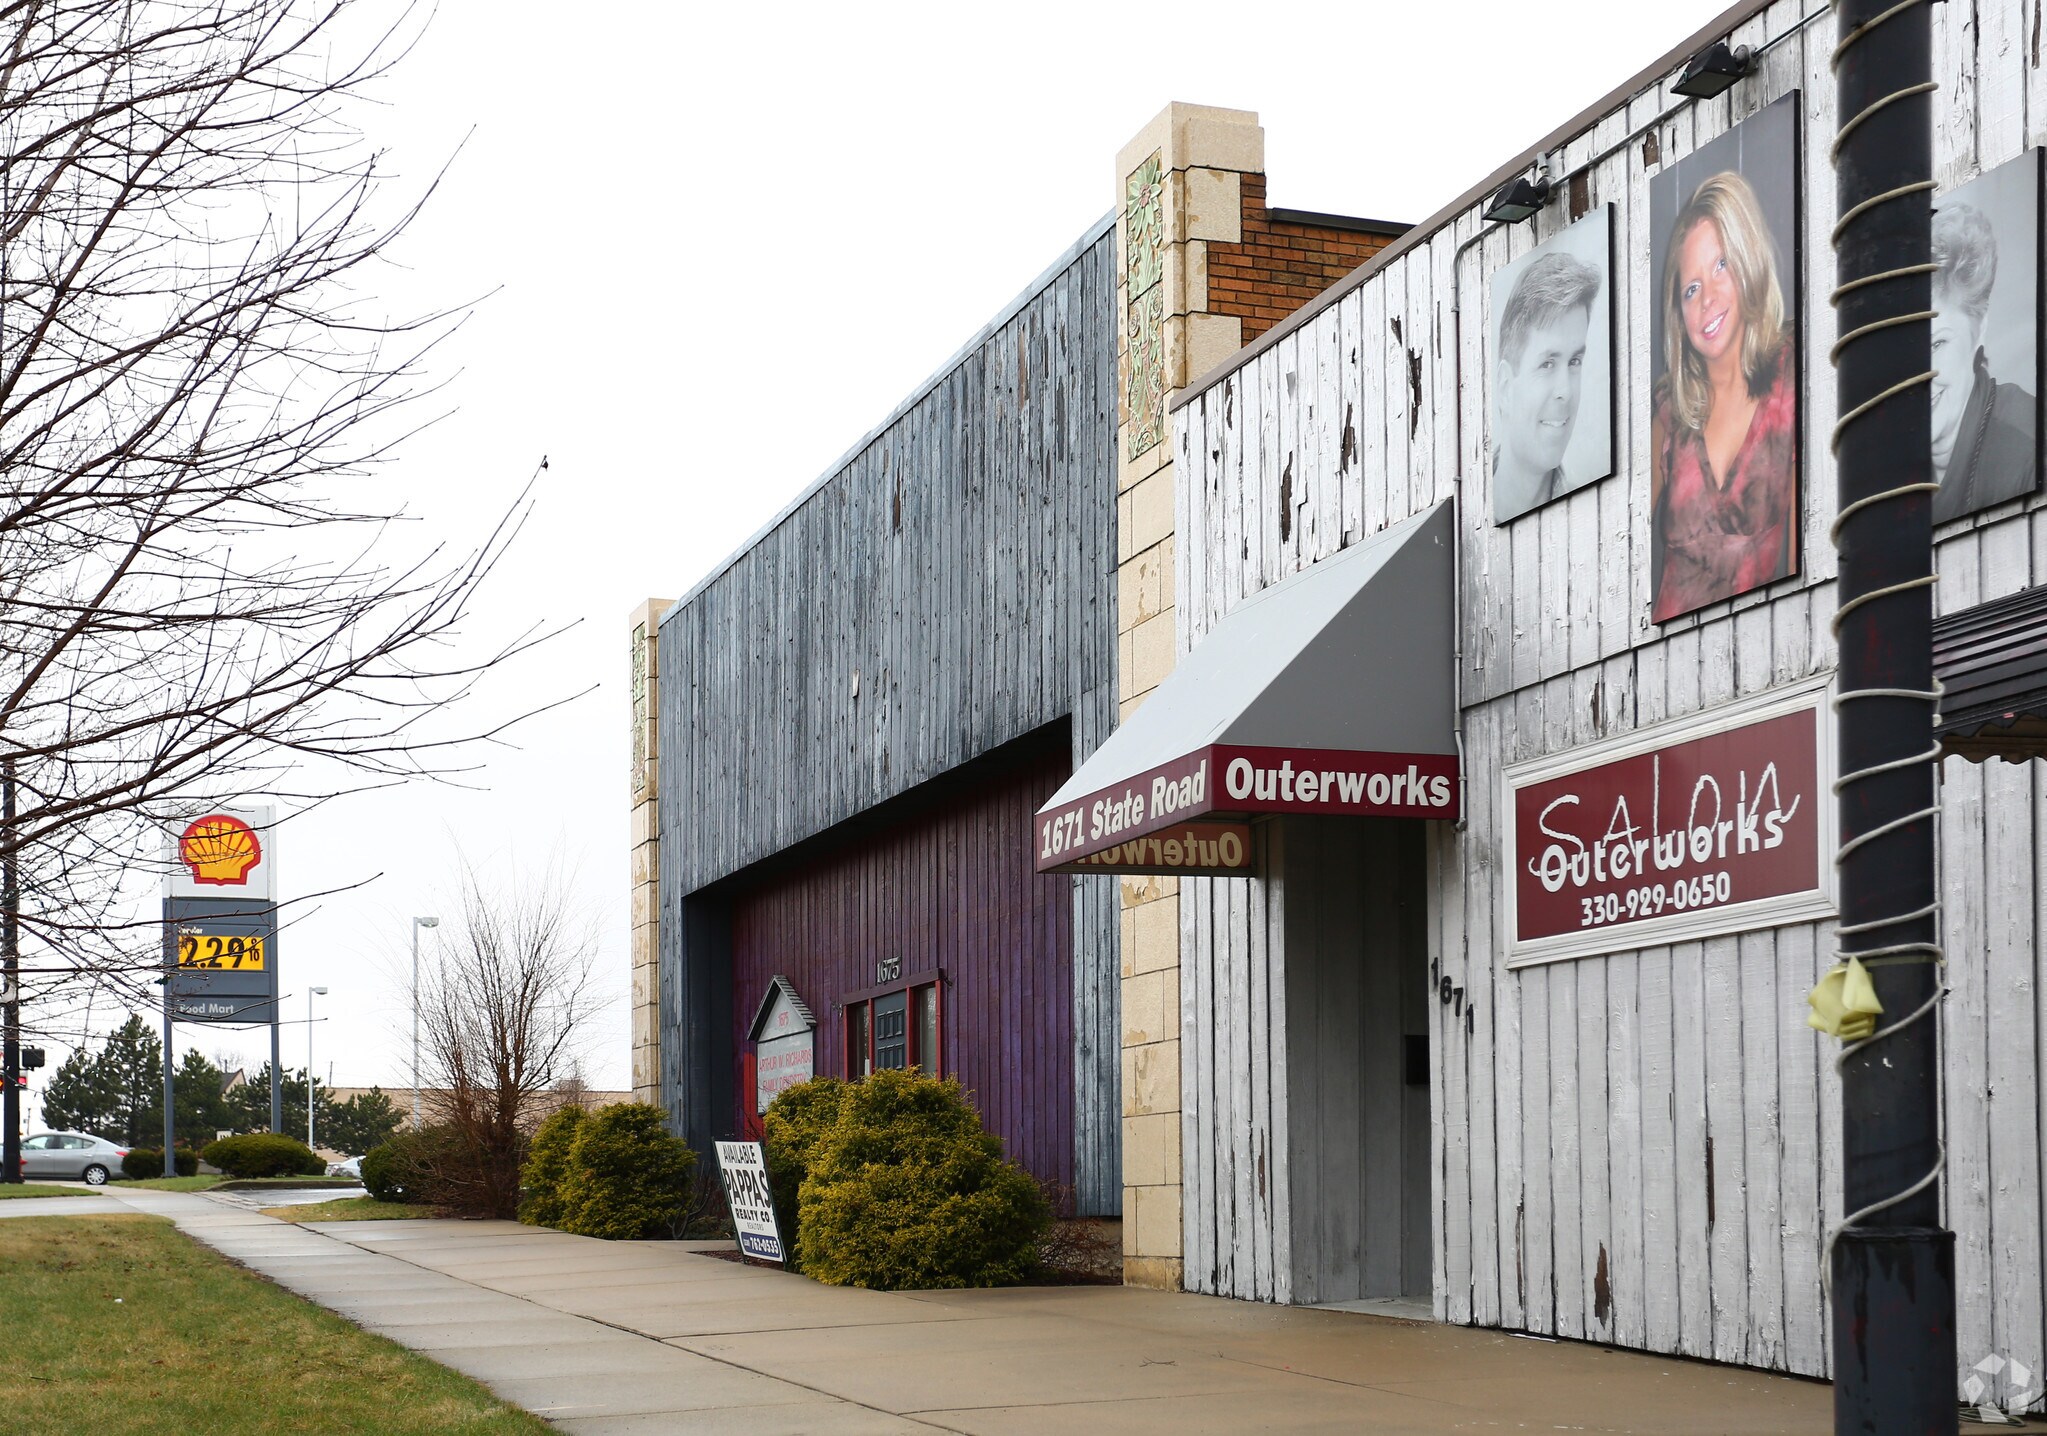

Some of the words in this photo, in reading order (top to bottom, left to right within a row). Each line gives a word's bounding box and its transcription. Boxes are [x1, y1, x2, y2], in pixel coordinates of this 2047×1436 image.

[1225, 757, 1451, 808] Outerworks
[1041, 807, 1085, 860] 1671
[1090, 788, 1144, 842] State
[1150, 759, 1207, 820] Road
[1540, 801, 1784, 893] Outerworks
[1580, 871, 1731, 927] 330-929-0650
[877, 956, 900, 984] 1675
[208, 1004, 234, 1014] Mart
[1431, 957, 1474, 1034] 1671
[723, 1144, 757, 1164] AVAILABLE
[722, 1168, 772, 1208] PAPPAS
[735, 1208, 759, 1221] REALTY
[760, 1210, 773, 1223] CO.
[750, 1237, 779, 1254] 762-0535
